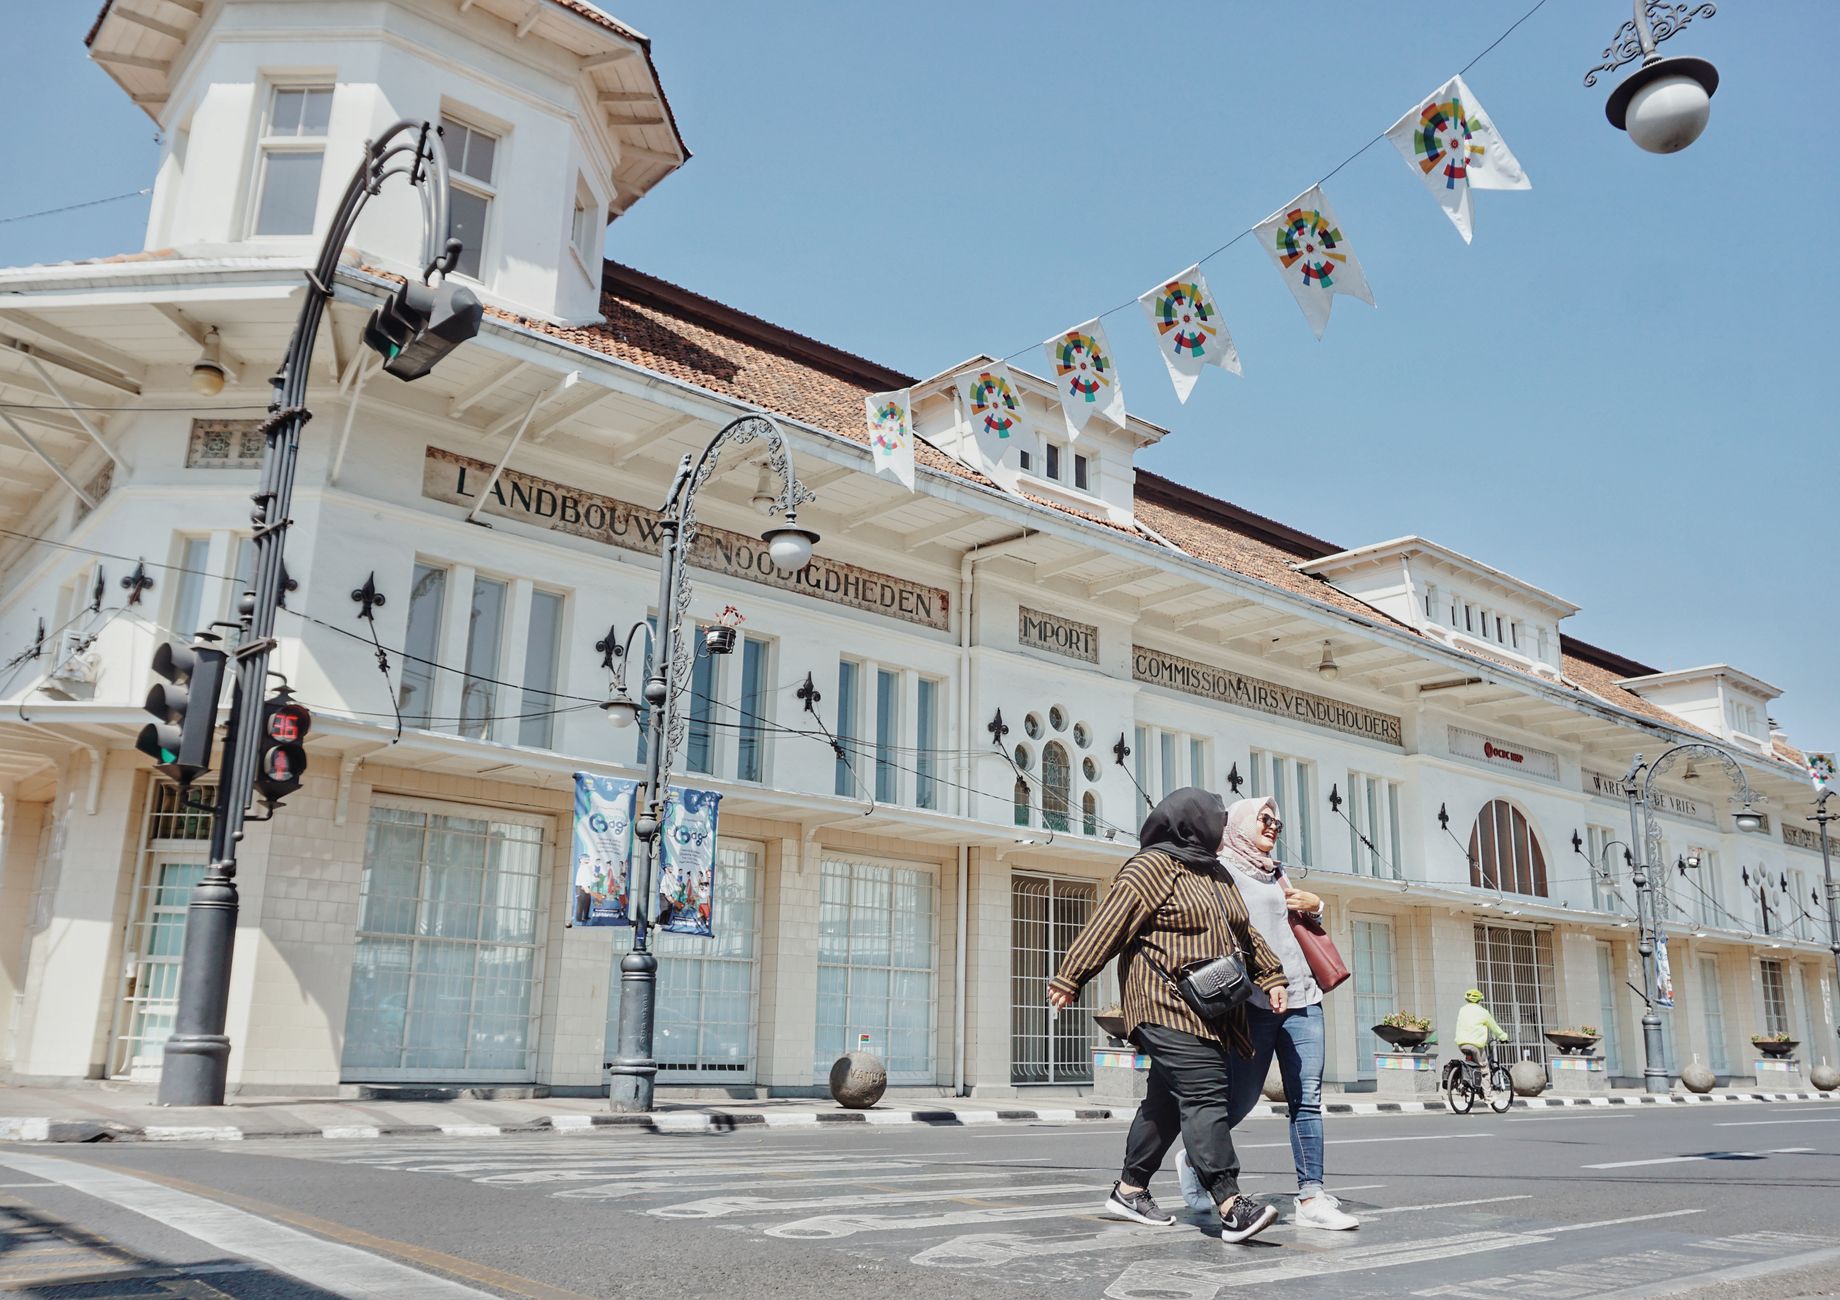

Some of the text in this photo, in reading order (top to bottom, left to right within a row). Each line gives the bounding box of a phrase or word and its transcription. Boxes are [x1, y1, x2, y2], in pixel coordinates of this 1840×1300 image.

[1023, 615, 1094, 654] IMPORT
[271, 713, 299, 739] 36
[1669, 796, 1697, 816] VRIES
